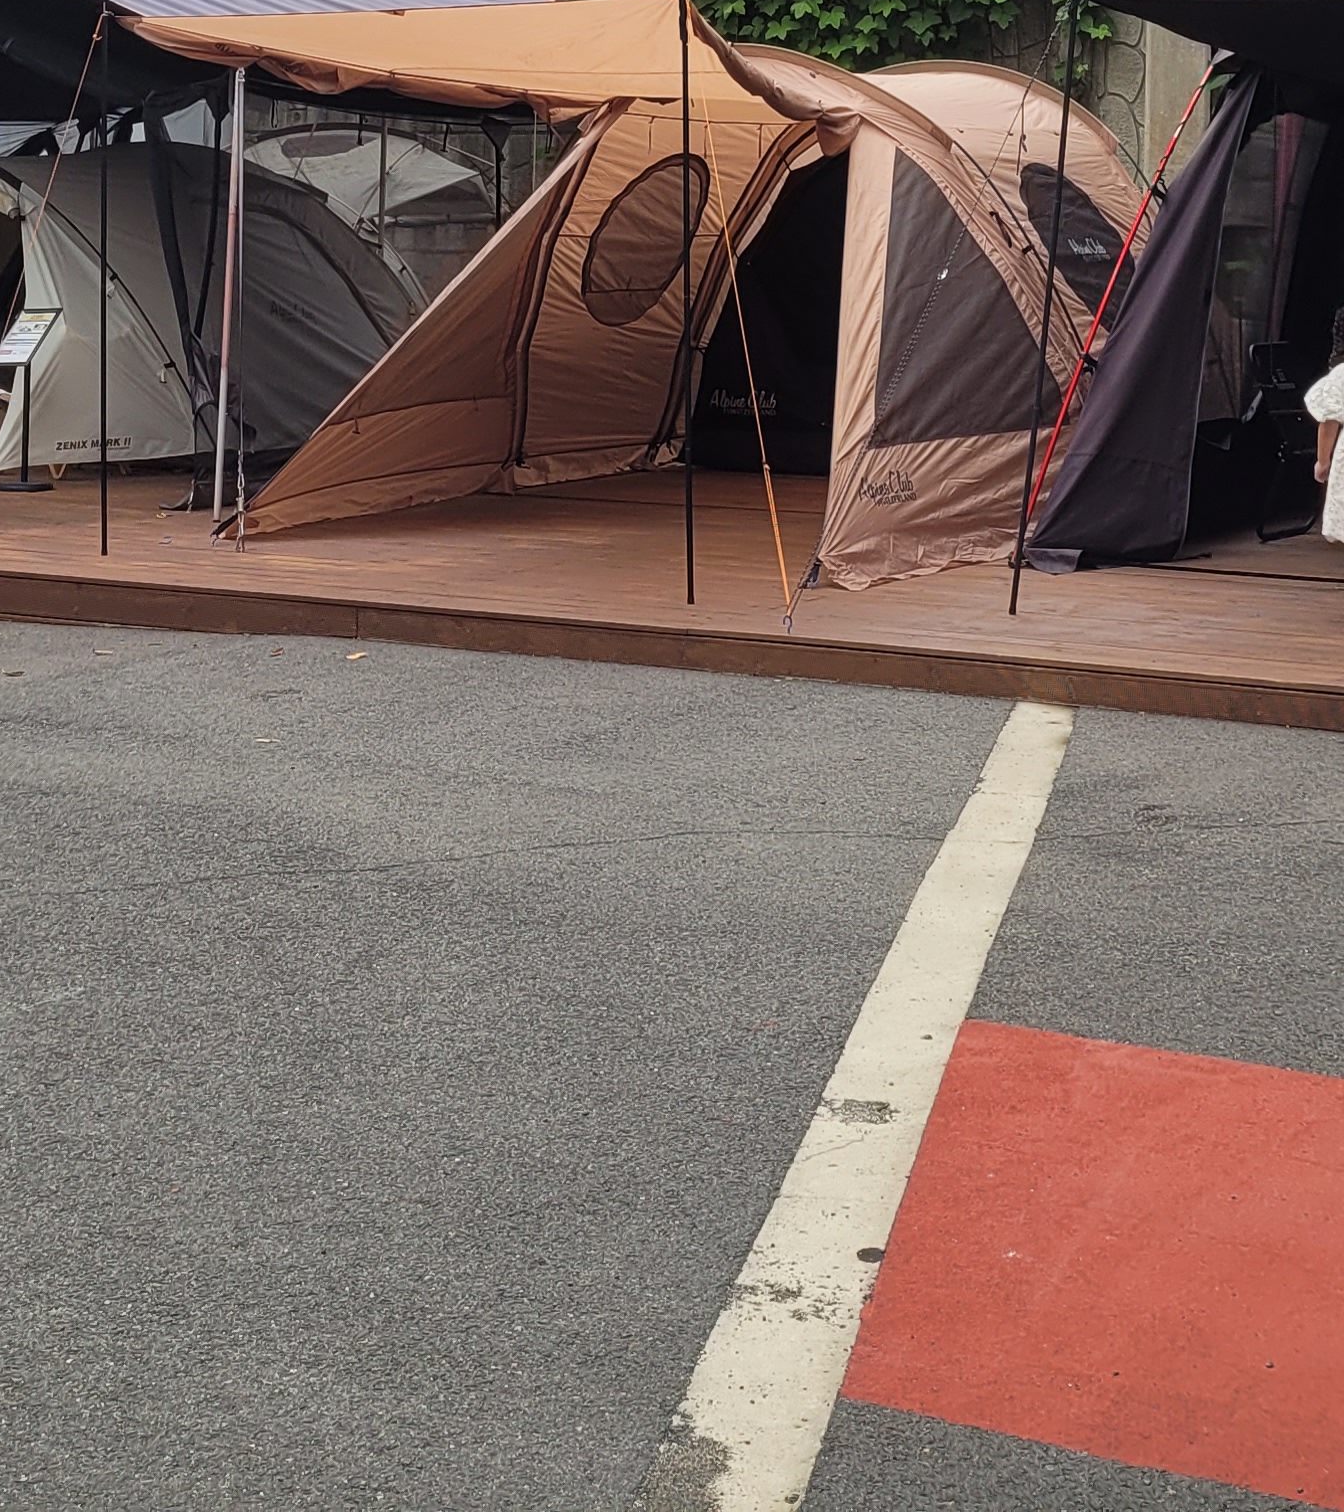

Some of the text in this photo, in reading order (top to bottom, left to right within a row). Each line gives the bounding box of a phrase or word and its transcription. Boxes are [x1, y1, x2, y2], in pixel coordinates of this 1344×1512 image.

[710, 389, 746, 412] Alpine
[56, 440, 88, 451] ZENIX
[91, 438, 121, 449] MRK
[888, 470, 914, 494] Club
